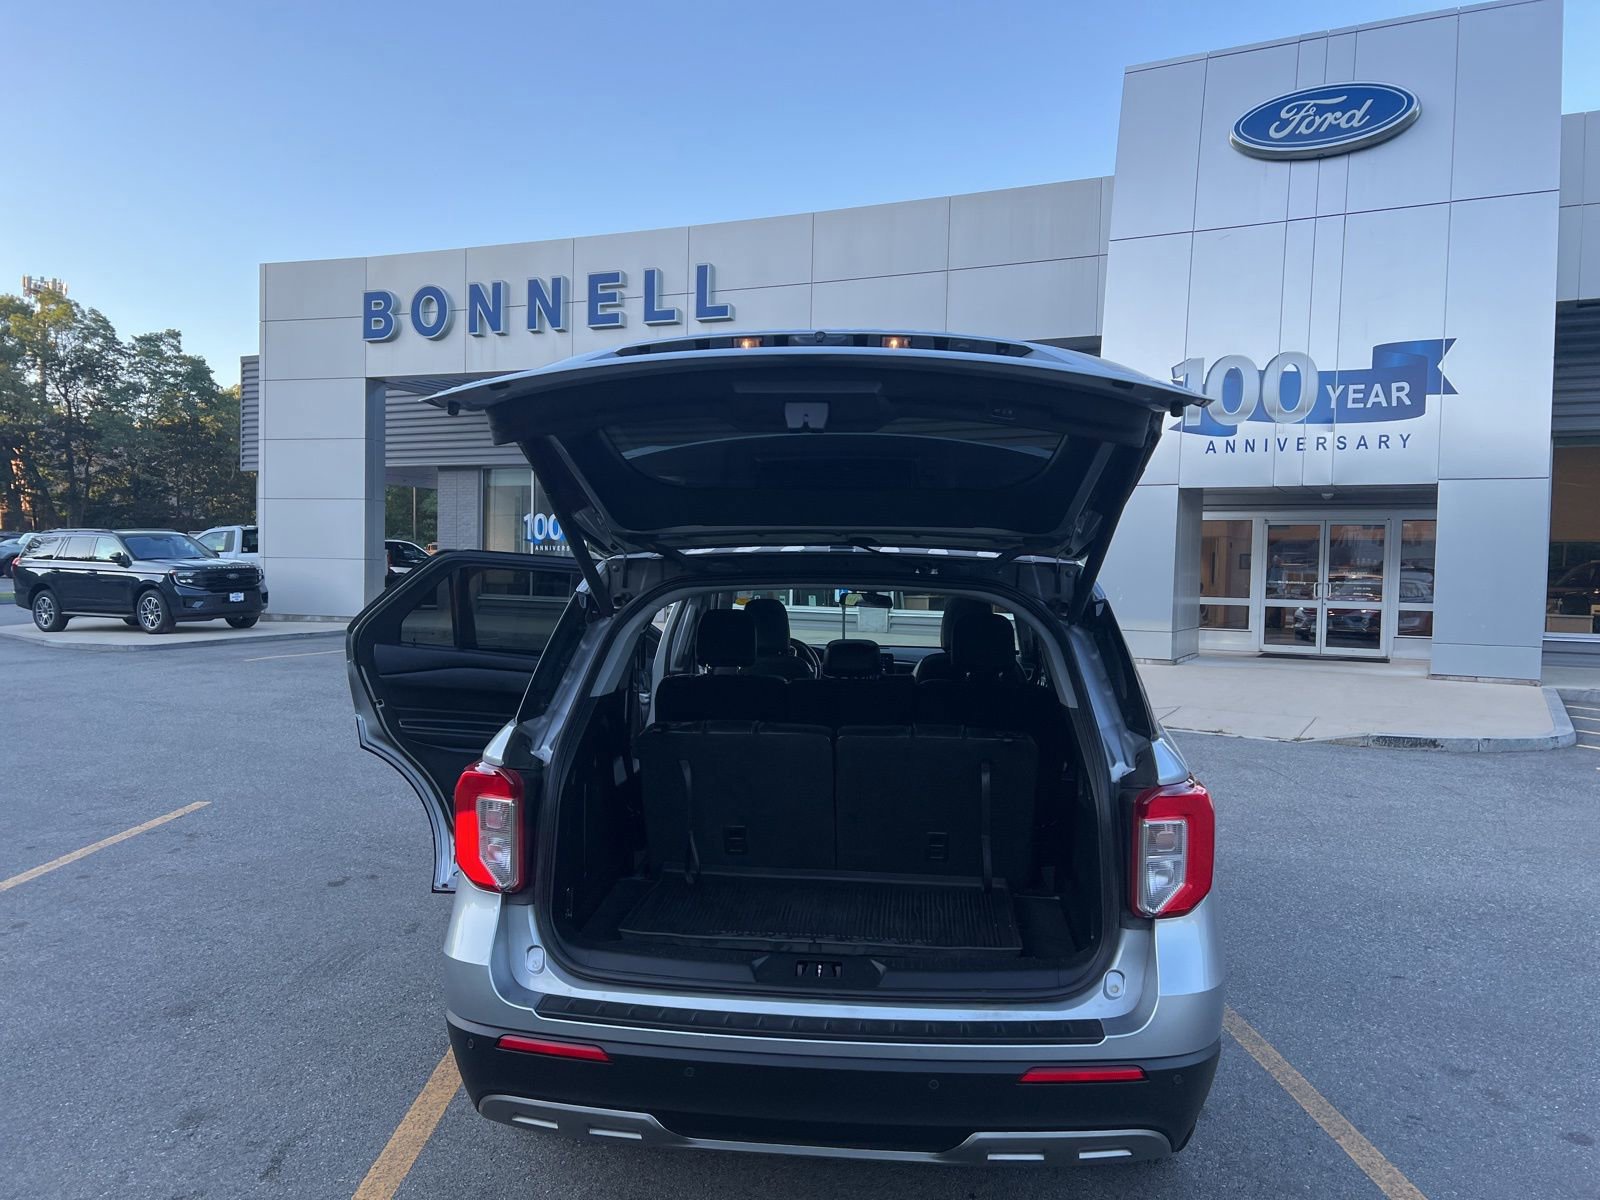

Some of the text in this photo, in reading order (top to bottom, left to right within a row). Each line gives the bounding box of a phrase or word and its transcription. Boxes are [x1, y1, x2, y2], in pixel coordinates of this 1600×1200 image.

[1268, 95, 1375, 139] Ford
[362, 263, 735, 343] BONNELL
[1171, 351, 1412, 427] 100 YEAR
[1205, 433, 1413, 455] ANNIVERSARY
